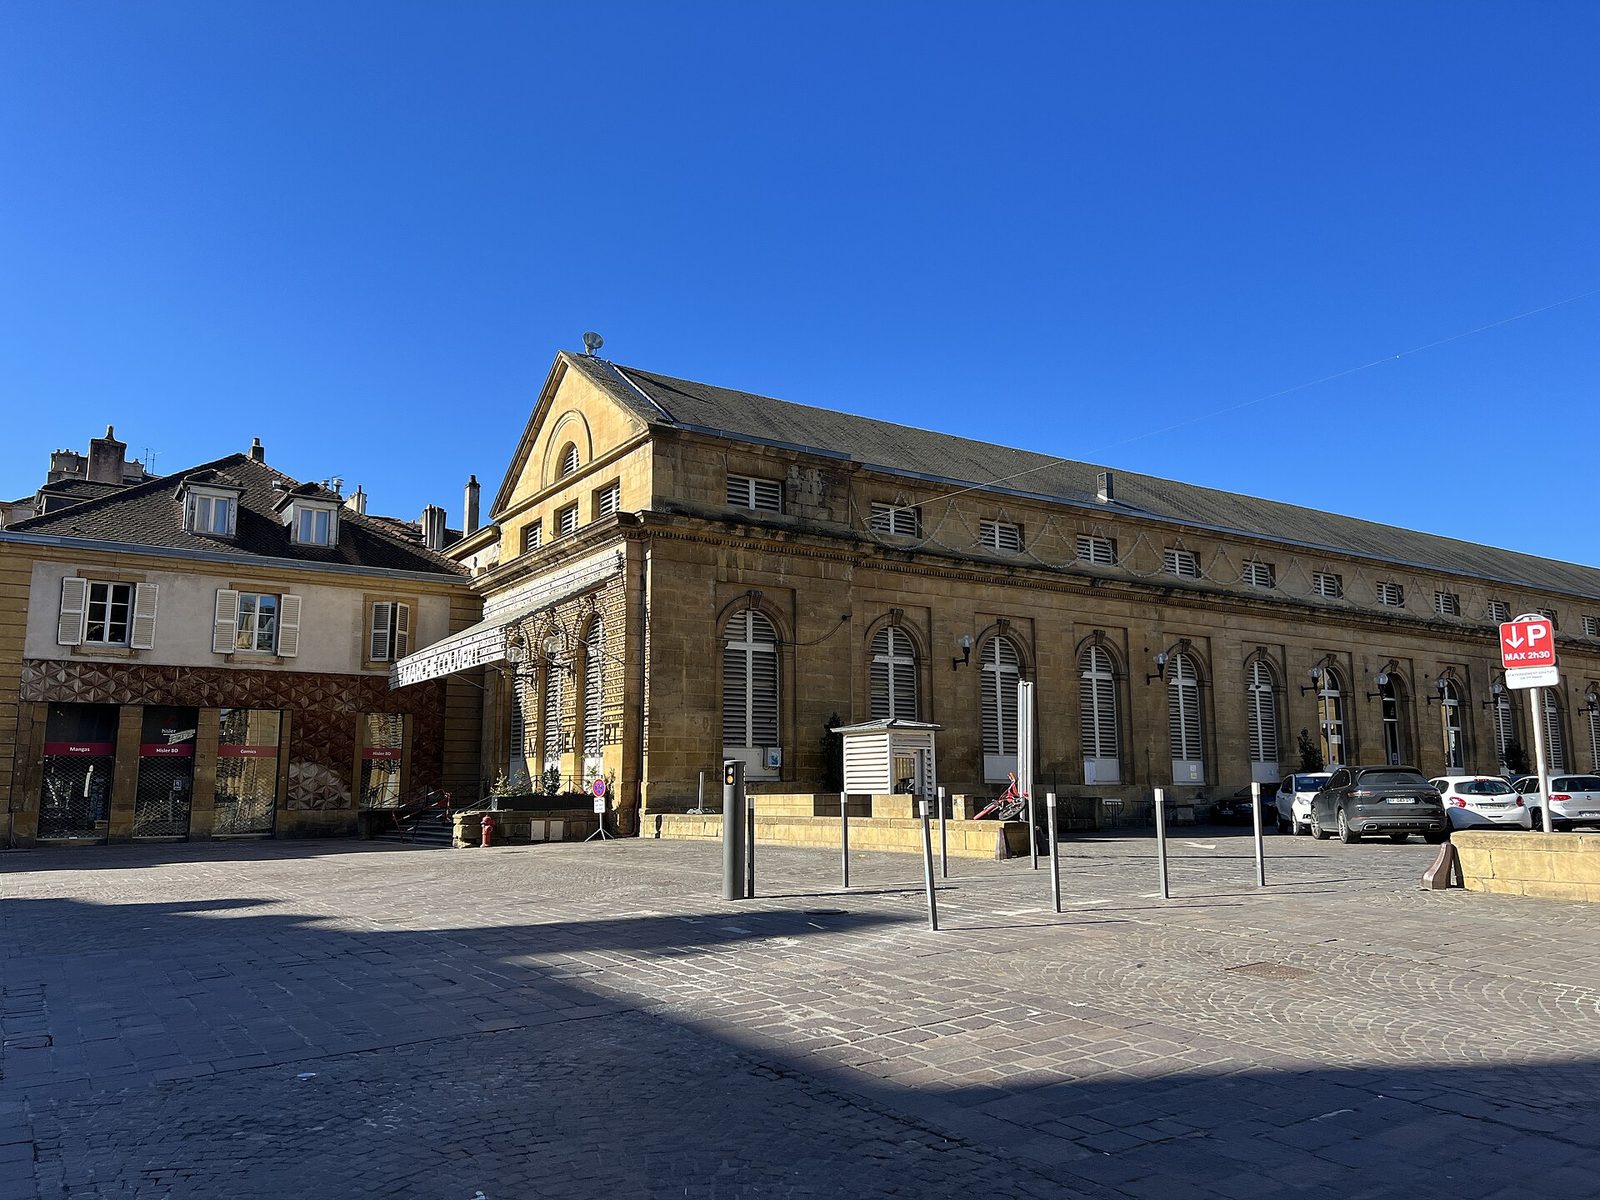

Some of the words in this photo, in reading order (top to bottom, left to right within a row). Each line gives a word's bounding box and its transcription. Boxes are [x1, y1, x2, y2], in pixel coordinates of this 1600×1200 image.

[1527, 624, 1547, 646] P
[1504, 652, 1526, 661] MAX
[1527, 650, 1550, 659] 2h30
